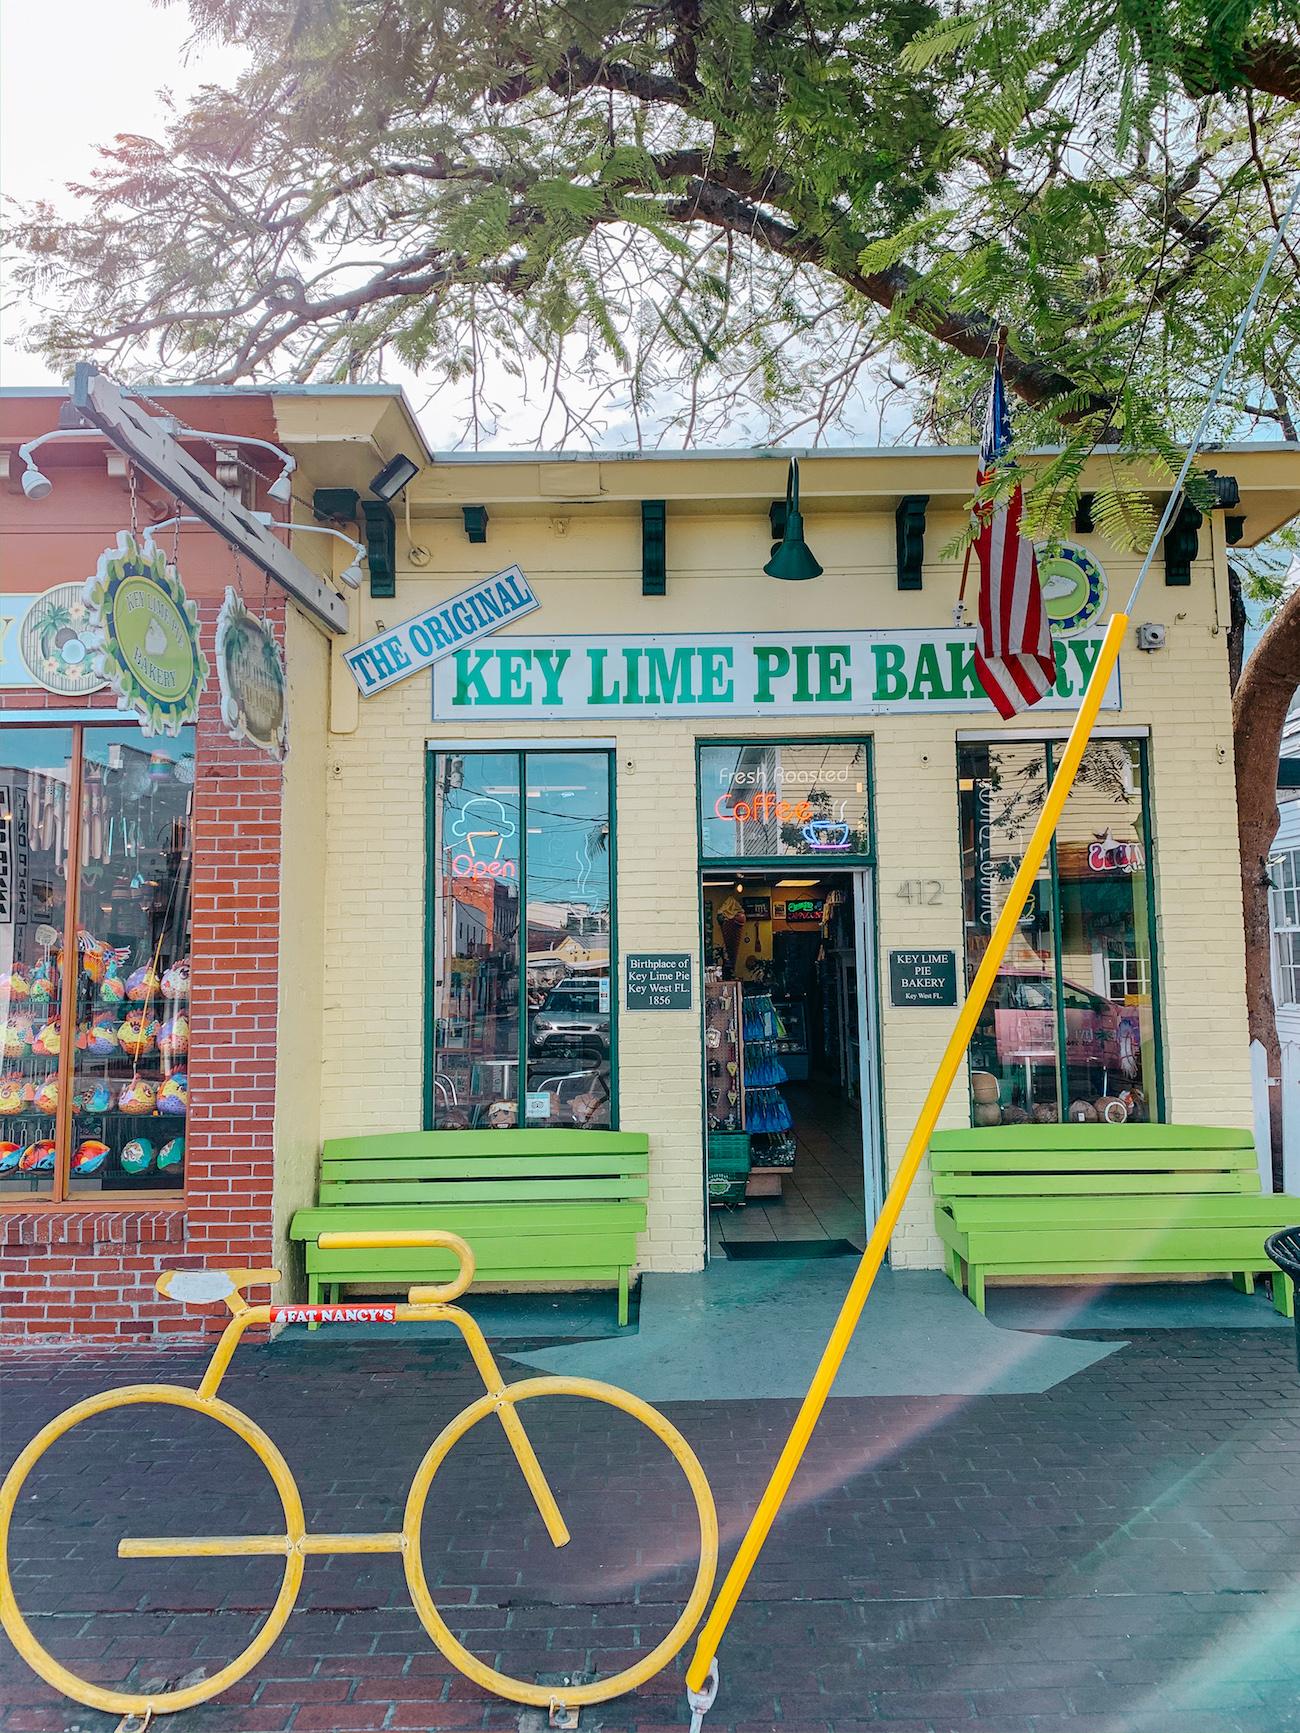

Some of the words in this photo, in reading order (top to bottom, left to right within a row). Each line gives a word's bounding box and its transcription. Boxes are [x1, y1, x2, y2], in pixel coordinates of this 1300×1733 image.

[126, 591, 145, 612] KEY
[350, 635, 411, 688] THE
[408, 574, 533, 657] ORIGINAL
[134, 646, 177, 688] BAKERY
[452, 649, 571, 705] KEY
[587, 647, 734, 704] LIME
[753, 645, 851, 703] PIE
[871, 640, 1104, 701] BAKRY
[719, 766, 766, 784] Fresh
[774, 766, 849, 783] Roasted
[714, 793, 813, 821] Coffee
[452, 855, 515, 882] Open
[896, 880, 944, 905] 412
[630, 959, 676, 970] Birthplace
[678, 959, 690, 968] of
[897, 955, 919, 964] KEY
[921, 955, 949, 964] LIME
[628, 971, 647, 983] Key
[650, 971, 673, 980] Lime
[675, 971, 690, 980] Pie
[915, 967, 932, 975] PIE
[628, 984, 647, 995] Key
[649, 984, 672, 993] West
[674, 984, 690, 993] FL.
[901, 978, 946, 987] BAKERY
[649, 996, 671, 1005] 1856
[287, 1310, 318, 1322] FAT
[321, 1309, 394, 1322] NANCY'S
